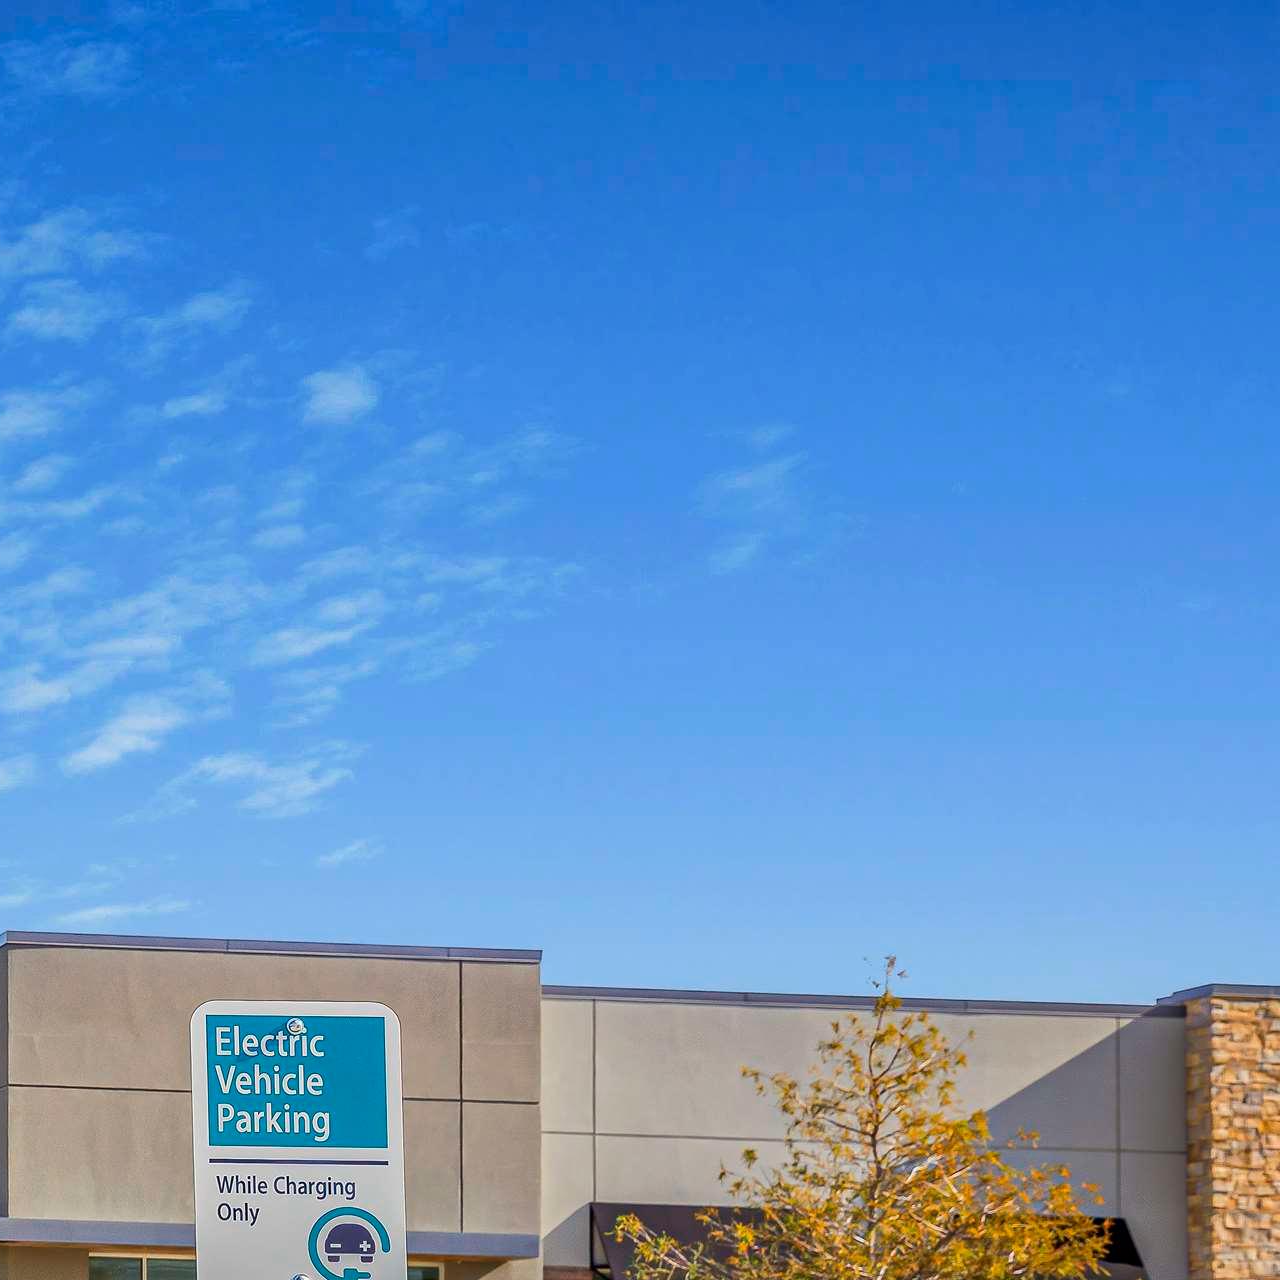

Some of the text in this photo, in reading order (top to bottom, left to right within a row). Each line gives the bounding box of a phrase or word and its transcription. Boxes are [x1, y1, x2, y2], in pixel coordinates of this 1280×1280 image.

[215, 1026, 325, 1057] Electric
[215, 1064, 324, 1095] Vehicle
[217, 1103, 330, 1142] Parking
[216, 1175, 356, 1200] While Charging
[217, 1202, 260, 1227] Only
